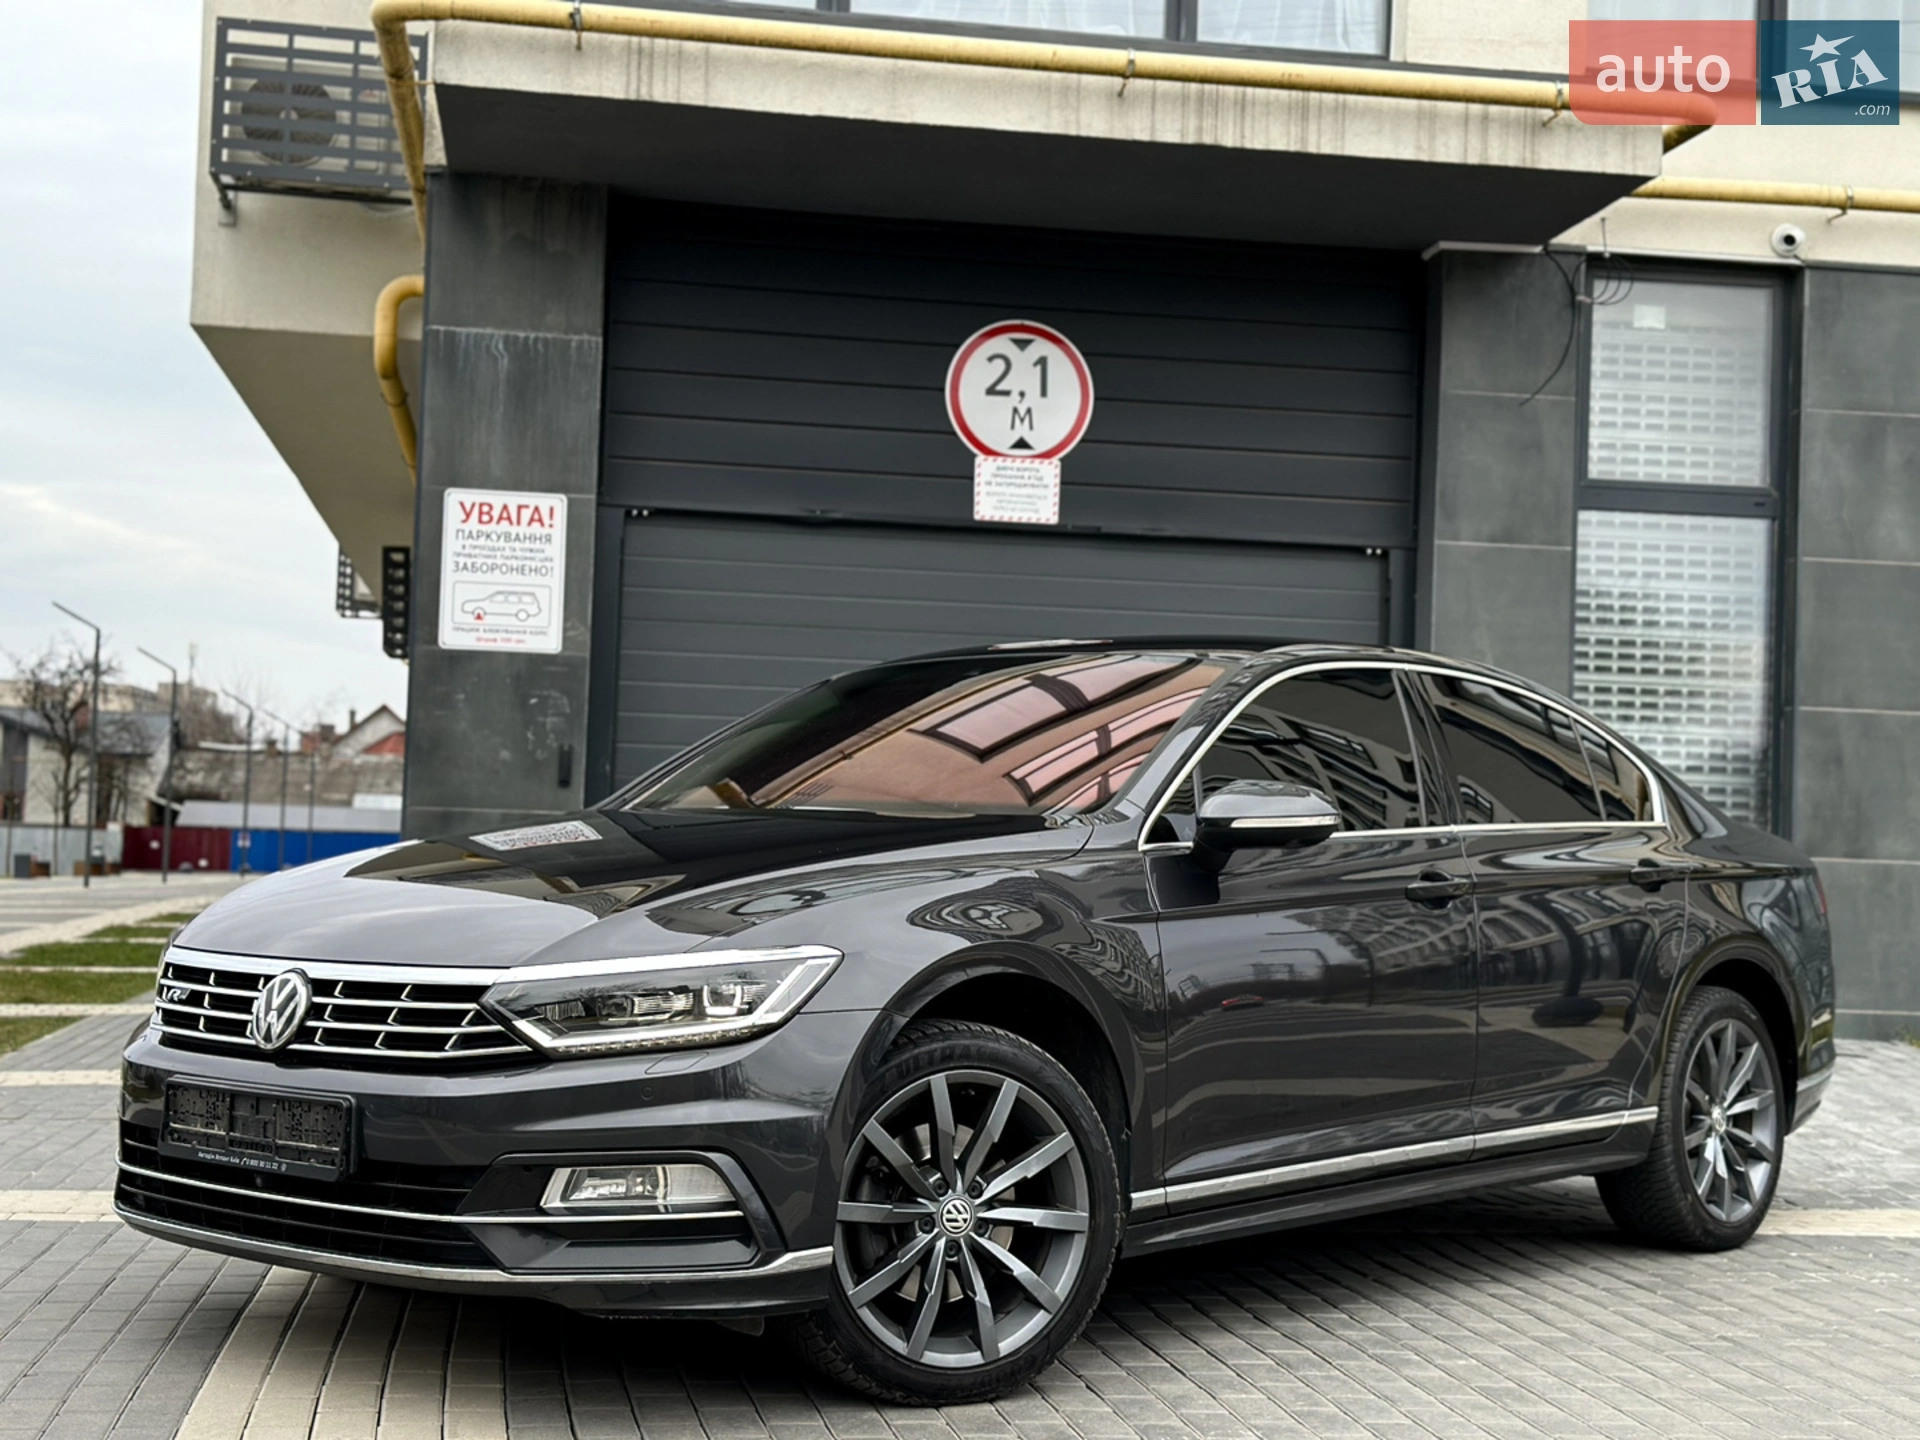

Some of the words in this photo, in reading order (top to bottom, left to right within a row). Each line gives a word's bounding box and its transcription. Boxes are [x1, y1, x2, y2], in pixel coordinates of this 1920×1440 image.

[985, 353, 1048, 403] 2,1
[1010, 406, 1034, 431] М
[459, 501, 554, 528] УВАГА!
[455, 529, 552, 544] ПАРКУВАННЯ
[452, 560, 554, 577] ЗАБОРОНЕНО!
